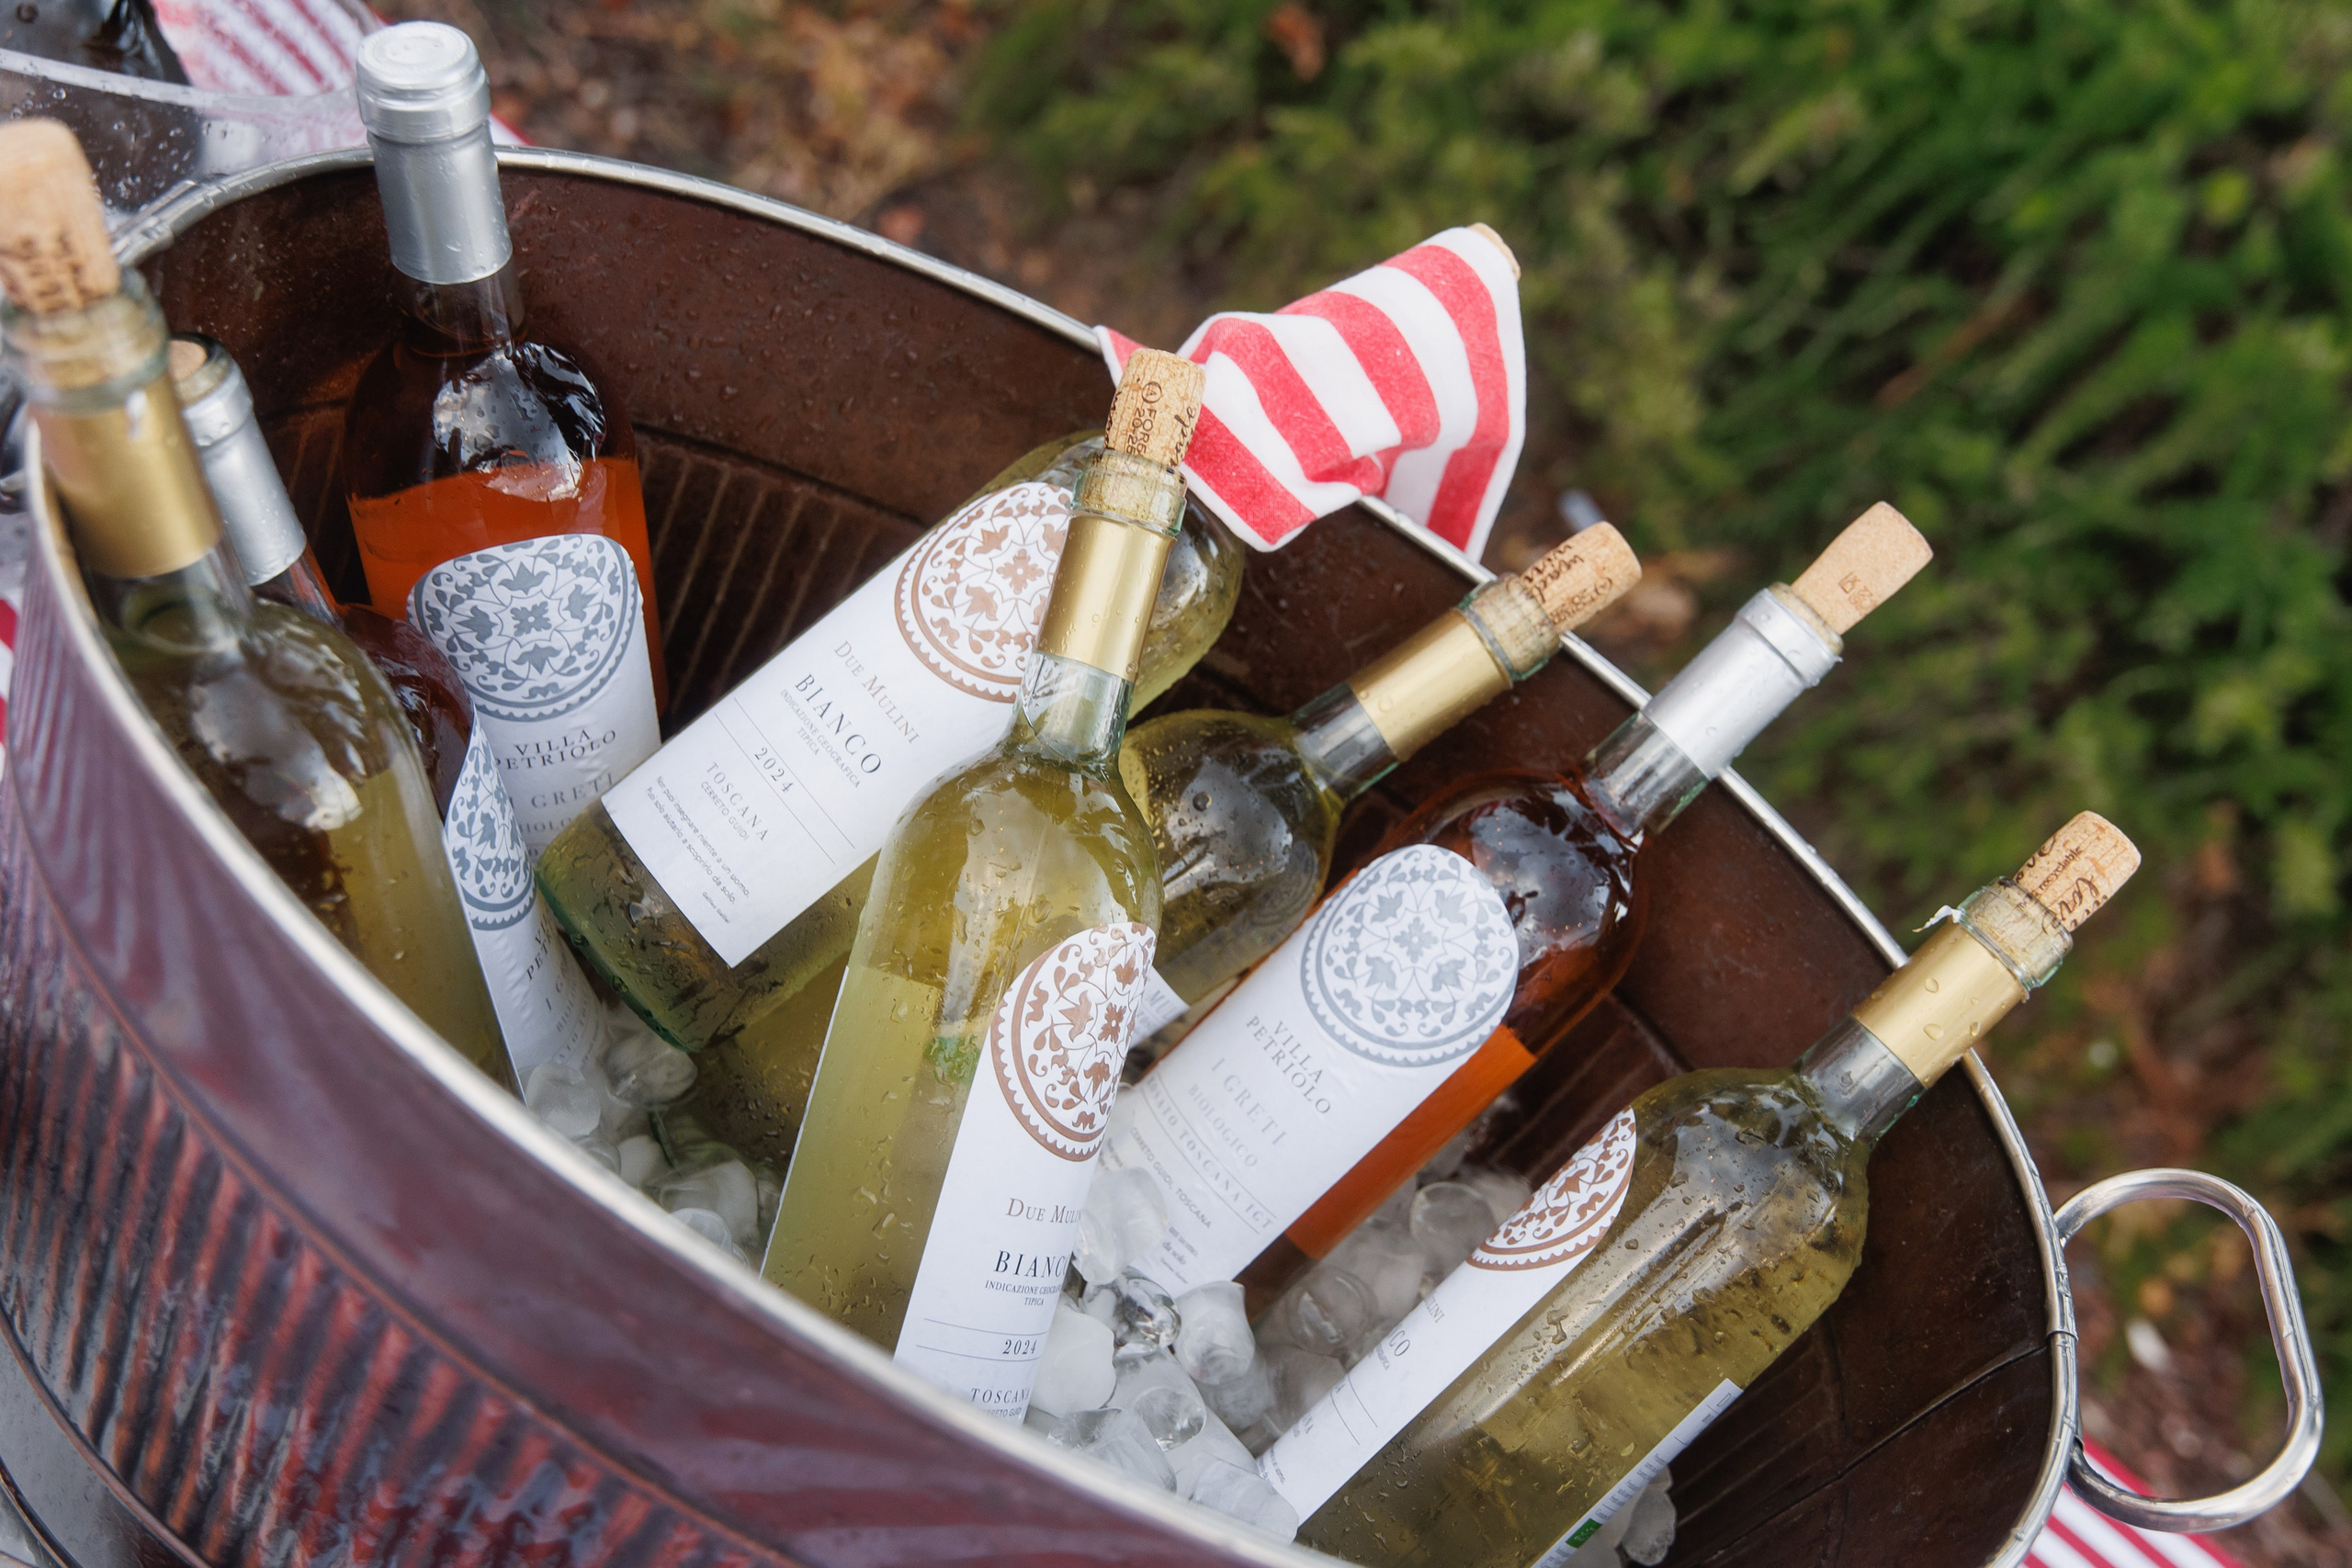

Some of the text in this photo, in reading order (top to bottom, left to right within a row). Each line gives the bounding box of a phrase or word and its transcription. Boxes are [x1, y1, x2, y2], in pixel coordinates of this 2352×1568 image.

[834, 641, 920, 744] DUE MULINI
[514, 729, 590, 756] VILLA
[781, 689, 860, 788] INDICAZIONE GEOGRAFICA
[796, 673, 881, 773] BIANCO
[797, 728, 820, 755] TIPICA
[531, 773, 614, 809] GRETI
[754, 747, 794, 793] 2024
[701, 781, 750, 840] CERRETO GUIDI
[707, 761, 768, 840] TOSCANA
[674, 800, 699, 834] insegnare
[698, 834, 718, 858] niente
[721, 863, 731, 874] un
[686, 844, 713, 875] scoprirlo
[712, 875, 721, 886] da
[1246, 1016, 1331, 1114] PETRIOLO
[1274, 1021, 1324, 1084] VILLA
[1188, 1084, 1258, 1168] BIOLOGICO
[1211, 1058, 1287, 1146] I GRETI
[1176, 1188, 1212, 1228] TOSCANA
[1180, 1130, 1240, 1202] TOSCANA
[1245, 1203, 1273, 1228] IGT
[1005, 1198, 1046, 1222] DUE
[985, 1280, 1039, 1295] INDICAZIONE
[1024, 1297, 1044, 1306] TIPICA
[1002, 1338, 1038, 1355] 2024
